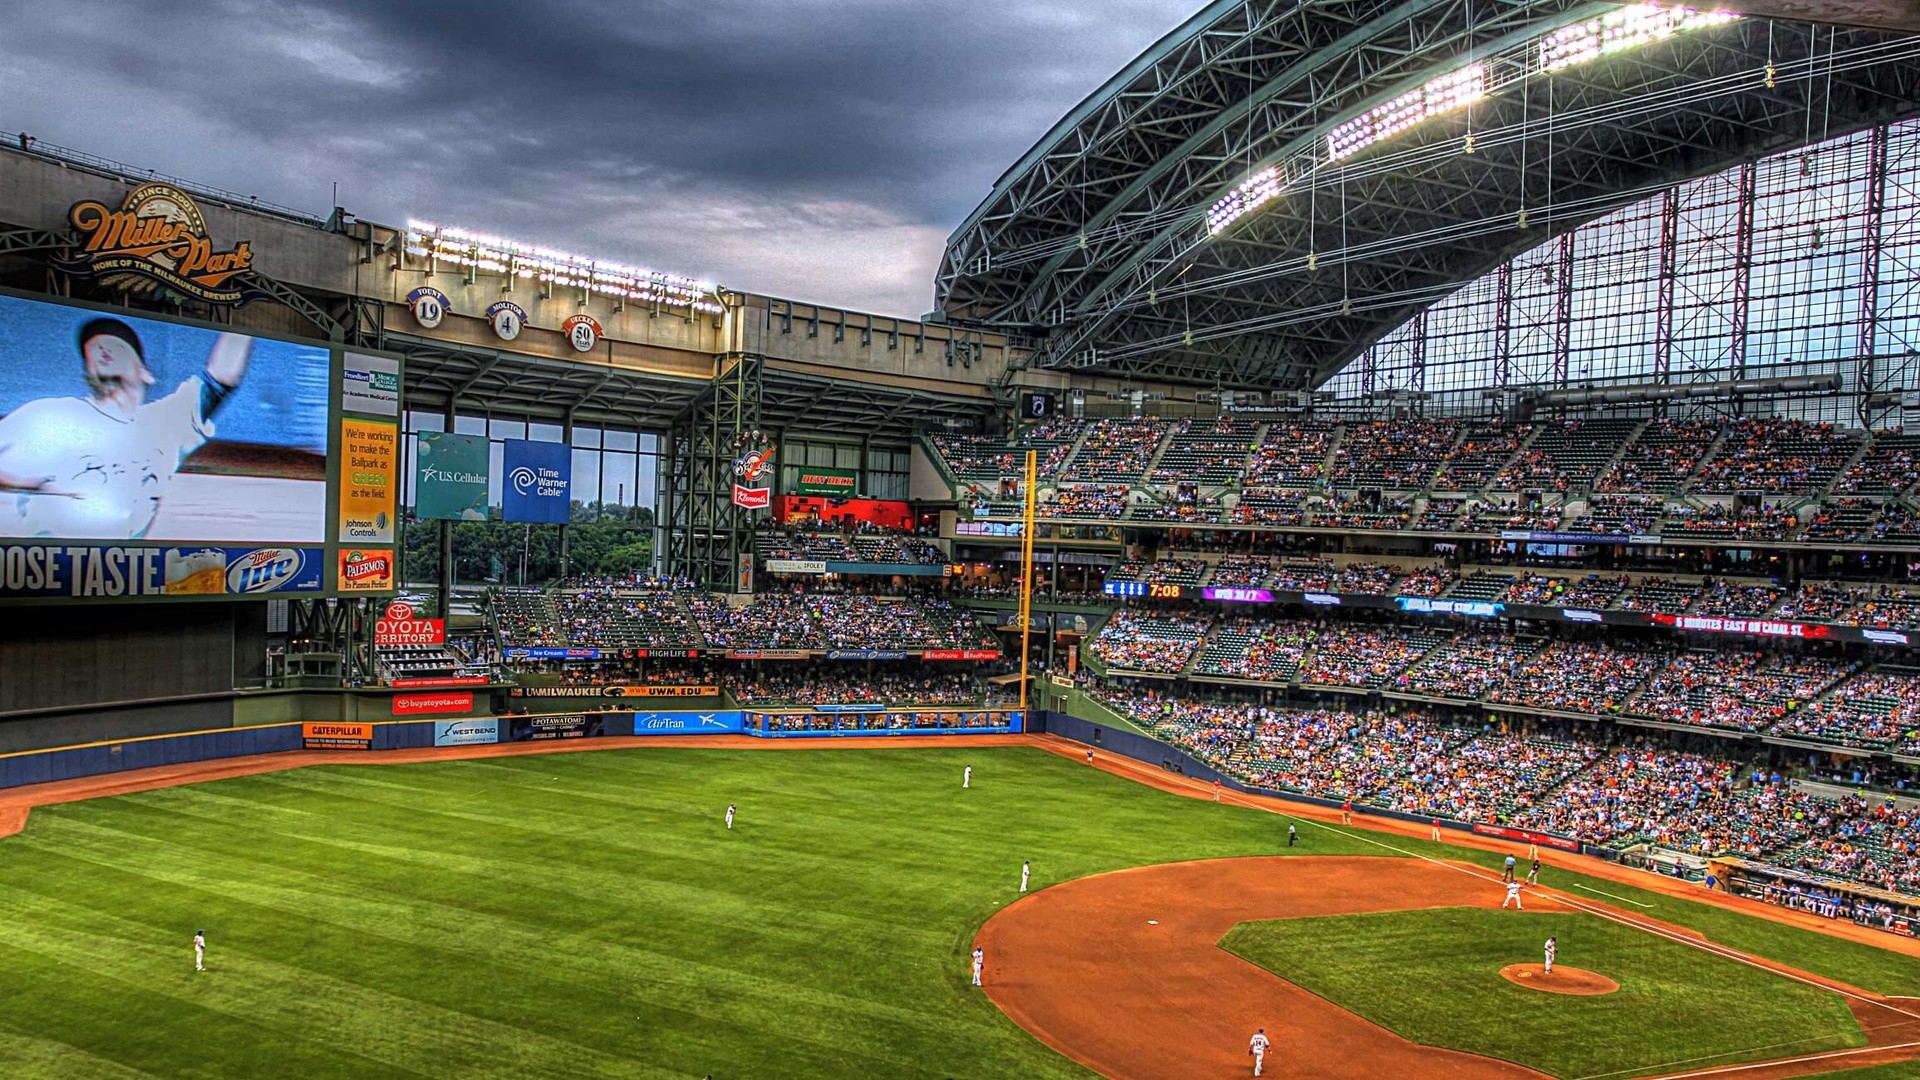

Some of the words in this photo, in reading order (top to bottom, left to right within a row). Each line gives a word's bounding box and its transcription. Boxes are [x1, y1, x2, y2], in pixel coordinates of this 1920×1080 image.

[137, 187, 169, 201] SINCE
[171, 191, 194, 212] 2001
[72, 203, 187, 251] Miller
[167, 231, 252, 277] Park
[93, 259, 119, 271] HOME
[120, 259, 133, 267] OF
[134, 260, 152, 272] THE
[153, 264, 202, 296] MILWAUKEE
[202, 289, 242, 300] BREWERS
[417, 287, 443, 299] YOUNT
[419, 302, 438, 320] 19
[492, 302, 523, 316] MOLITOR
[501, 316, 511, 333] 4
[575, 326, 590, 340] 50
[345, 428, 365, 439] We're
[366, 431, 394, 444] working
[349, 444, 358, 453] to
[359, 444, 378, 454] make
[378, 445, 390, 455] the
[351, 457, 378, 469] Ballpark
[380, 461, 388, 469] as
[453, 471, 487, 484] Cellular
[537, 467, 559, 478] Time
[537, 477, 568, 488] Warner
[351, 490, 359, 498] as
[360, 489, 370, 498] the
[537, 486, 561, 497] Cable
[345, 519, 373, 528] Johnson
[350, 528, 377, 537] Controls
[248, 550, 282, 567] Miller
[0, 546, 61, 590] OSE
[238, 558, 293, 592] Lite
[1150, 584, 1179, 597] 7:08
[1684, 617, 1722, 630] MINUTES
[1723, 620, 1746, 632] EAST
[1748, 621, 1761, 632] ON
[649, 650, 669, 658] HIGH
[670, 650, 687, 658] LIFE
[649, 687, 701, 696] UWM.EDU
[409, 698, 469, 708] buyatoyota.com
[536, 717, 581, 725] POTAWATOMI
[312, 725, 362, 736] CATERPILLAR
[452, 728, 474, 736] WEST
[474, 727, 496, 735] BEND
